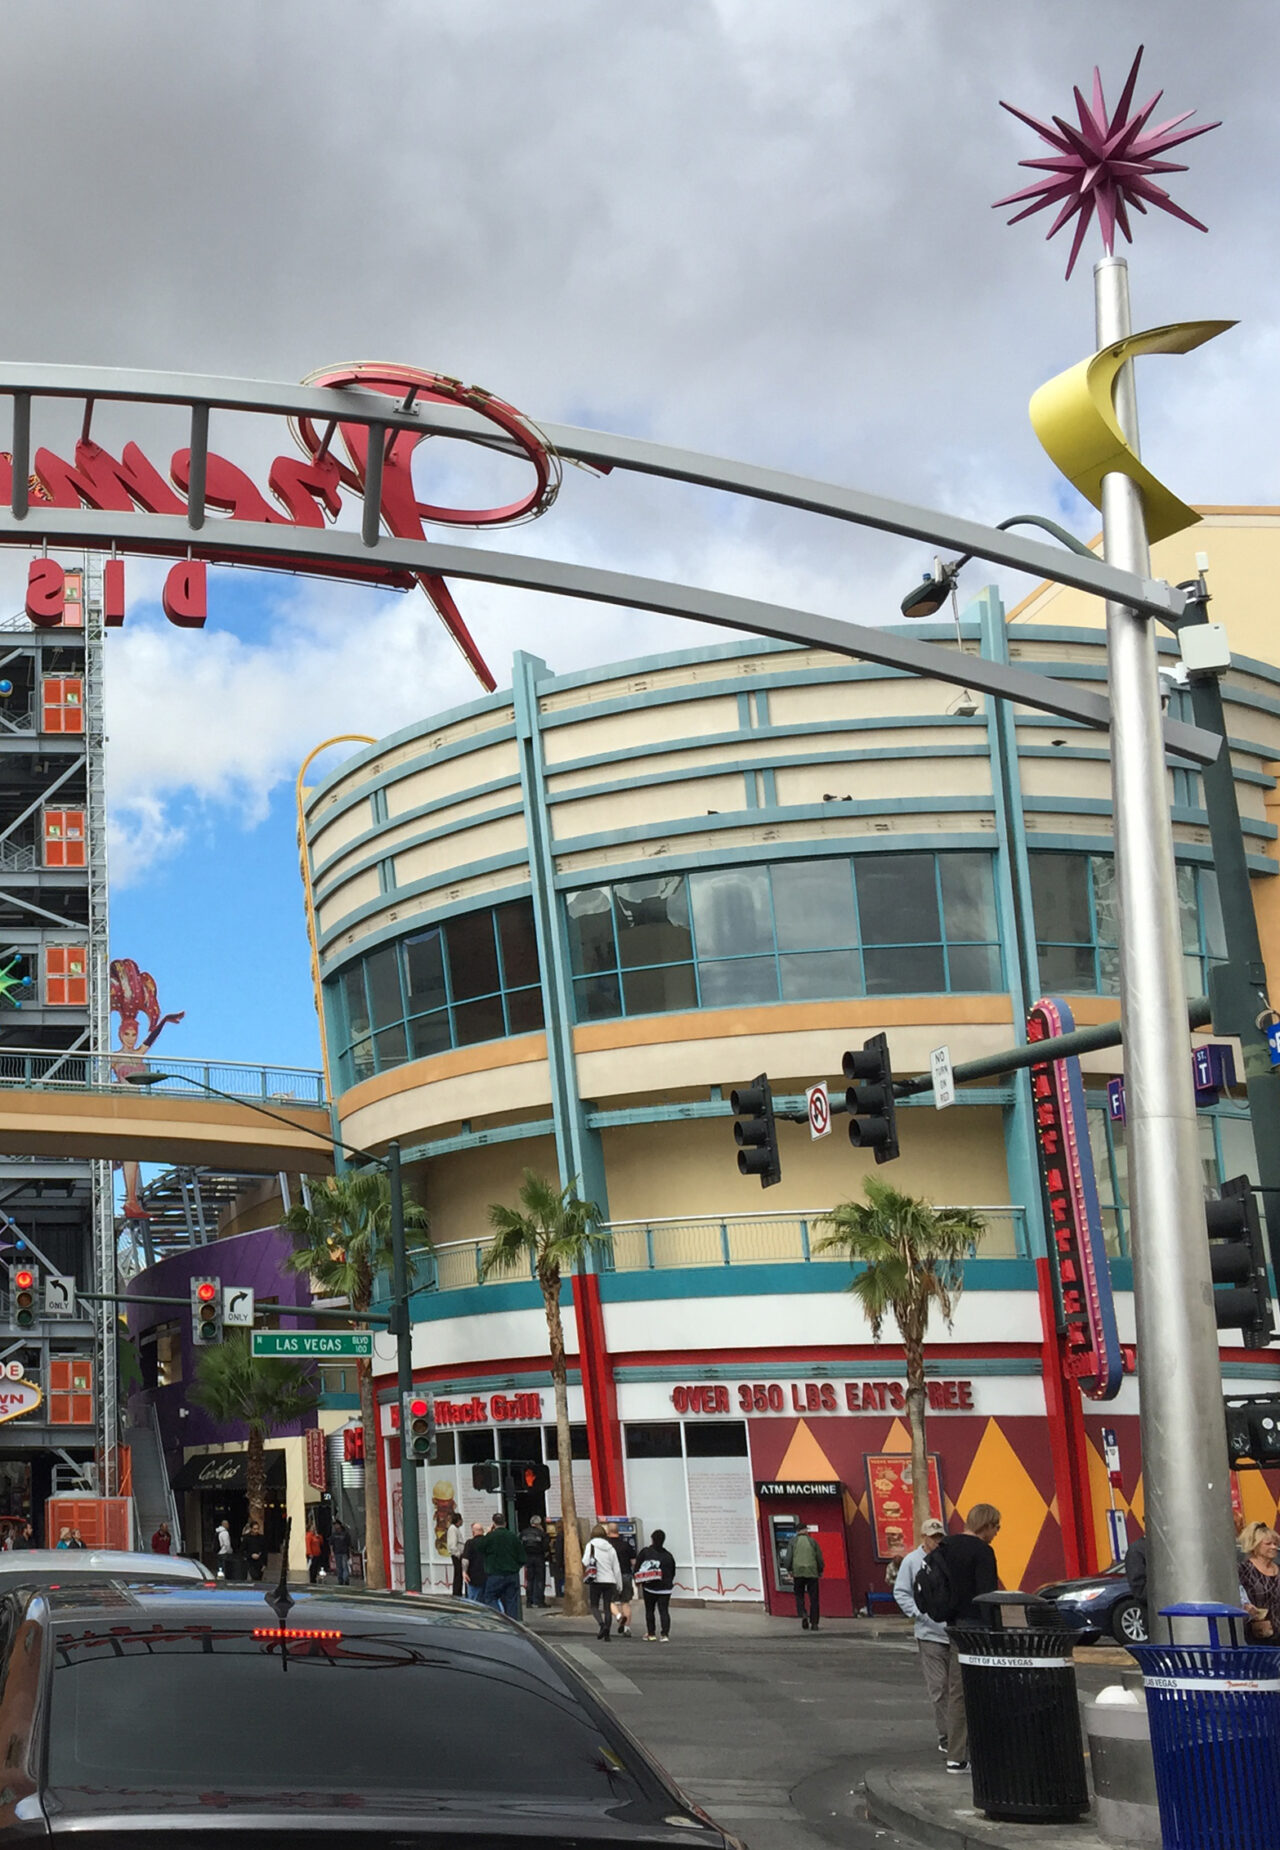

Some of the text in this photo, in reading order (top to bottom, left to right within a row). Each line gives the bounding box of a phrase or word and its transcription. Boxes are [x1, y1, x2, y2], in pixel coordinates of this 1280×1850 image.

[934, 1050, 945, 1064] NO
[49, 1300, 69, 1310] ONLY
[228, 1313, 248, 1322] ONLY
[256, 1335, 369, 1351] N LAS VEGAS BLVD
[355, 1345, 369, 1354] 100
[672, 1381, 975, 1413] OVER 350 LBS EATS REE
[490, 1393, 542, 1421] Grill
[312, 1430, 321, 1483] BREWERY
[760, 1484, 837, 1494] ATM MACHINE
[992, 1657, 1007, 1665] LAS
[1008, 1658, 1034, 1666] VEGAS
[1155, 1680, 1177, 1688] VEGAS
